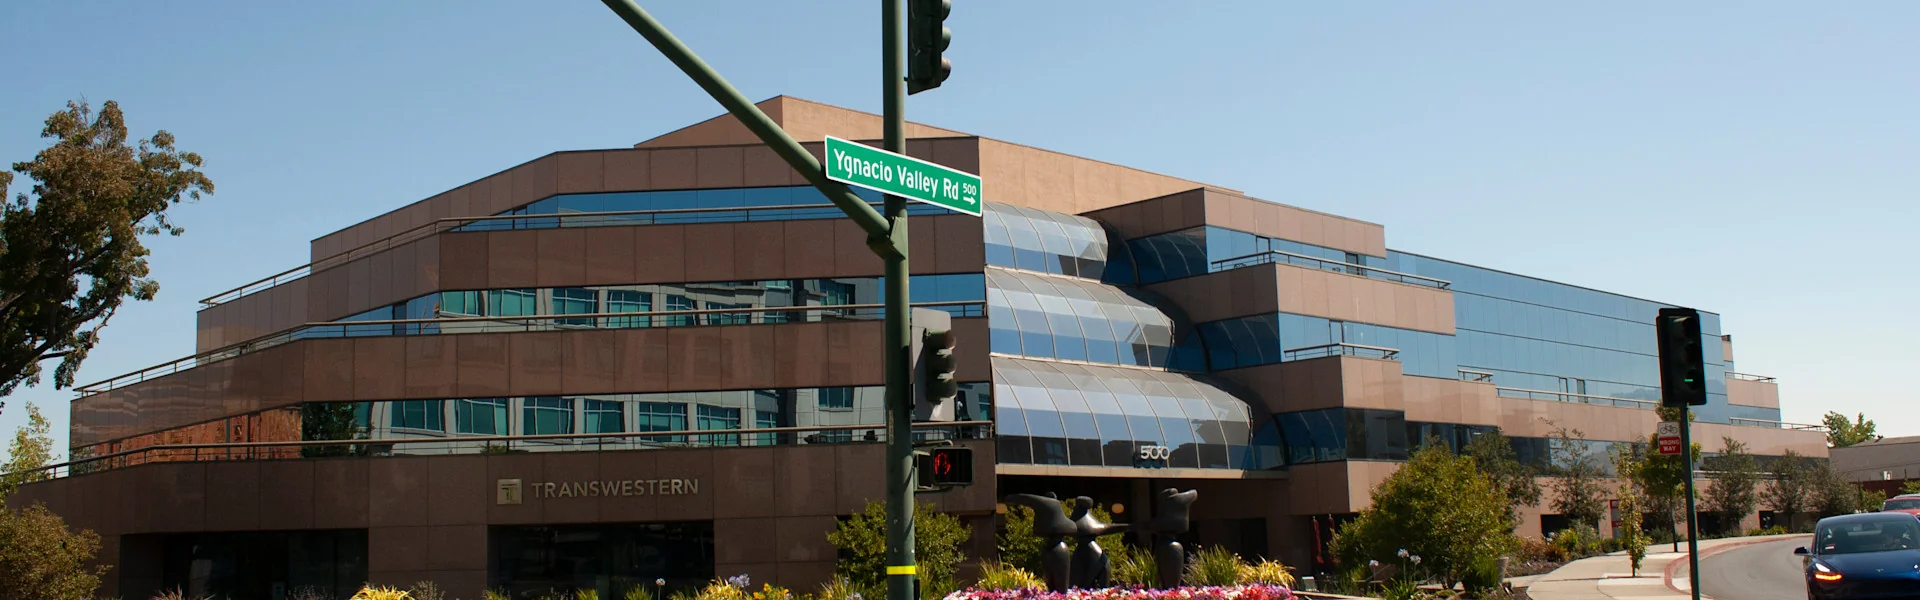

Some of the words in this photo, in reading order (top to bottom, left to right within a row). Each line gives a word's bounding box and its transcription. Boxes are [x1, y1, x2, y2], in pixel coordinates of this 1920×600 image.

[833, 148, 893, 183] Ygnacio
[897, 164, 939, 198] Valley
[943, 178, 959, 200] Rd
[962, 182, 977, 196] 500
[1140, 445, 1170, 460] 500
[531, 478, 699, 498] TRANSWESTERN
